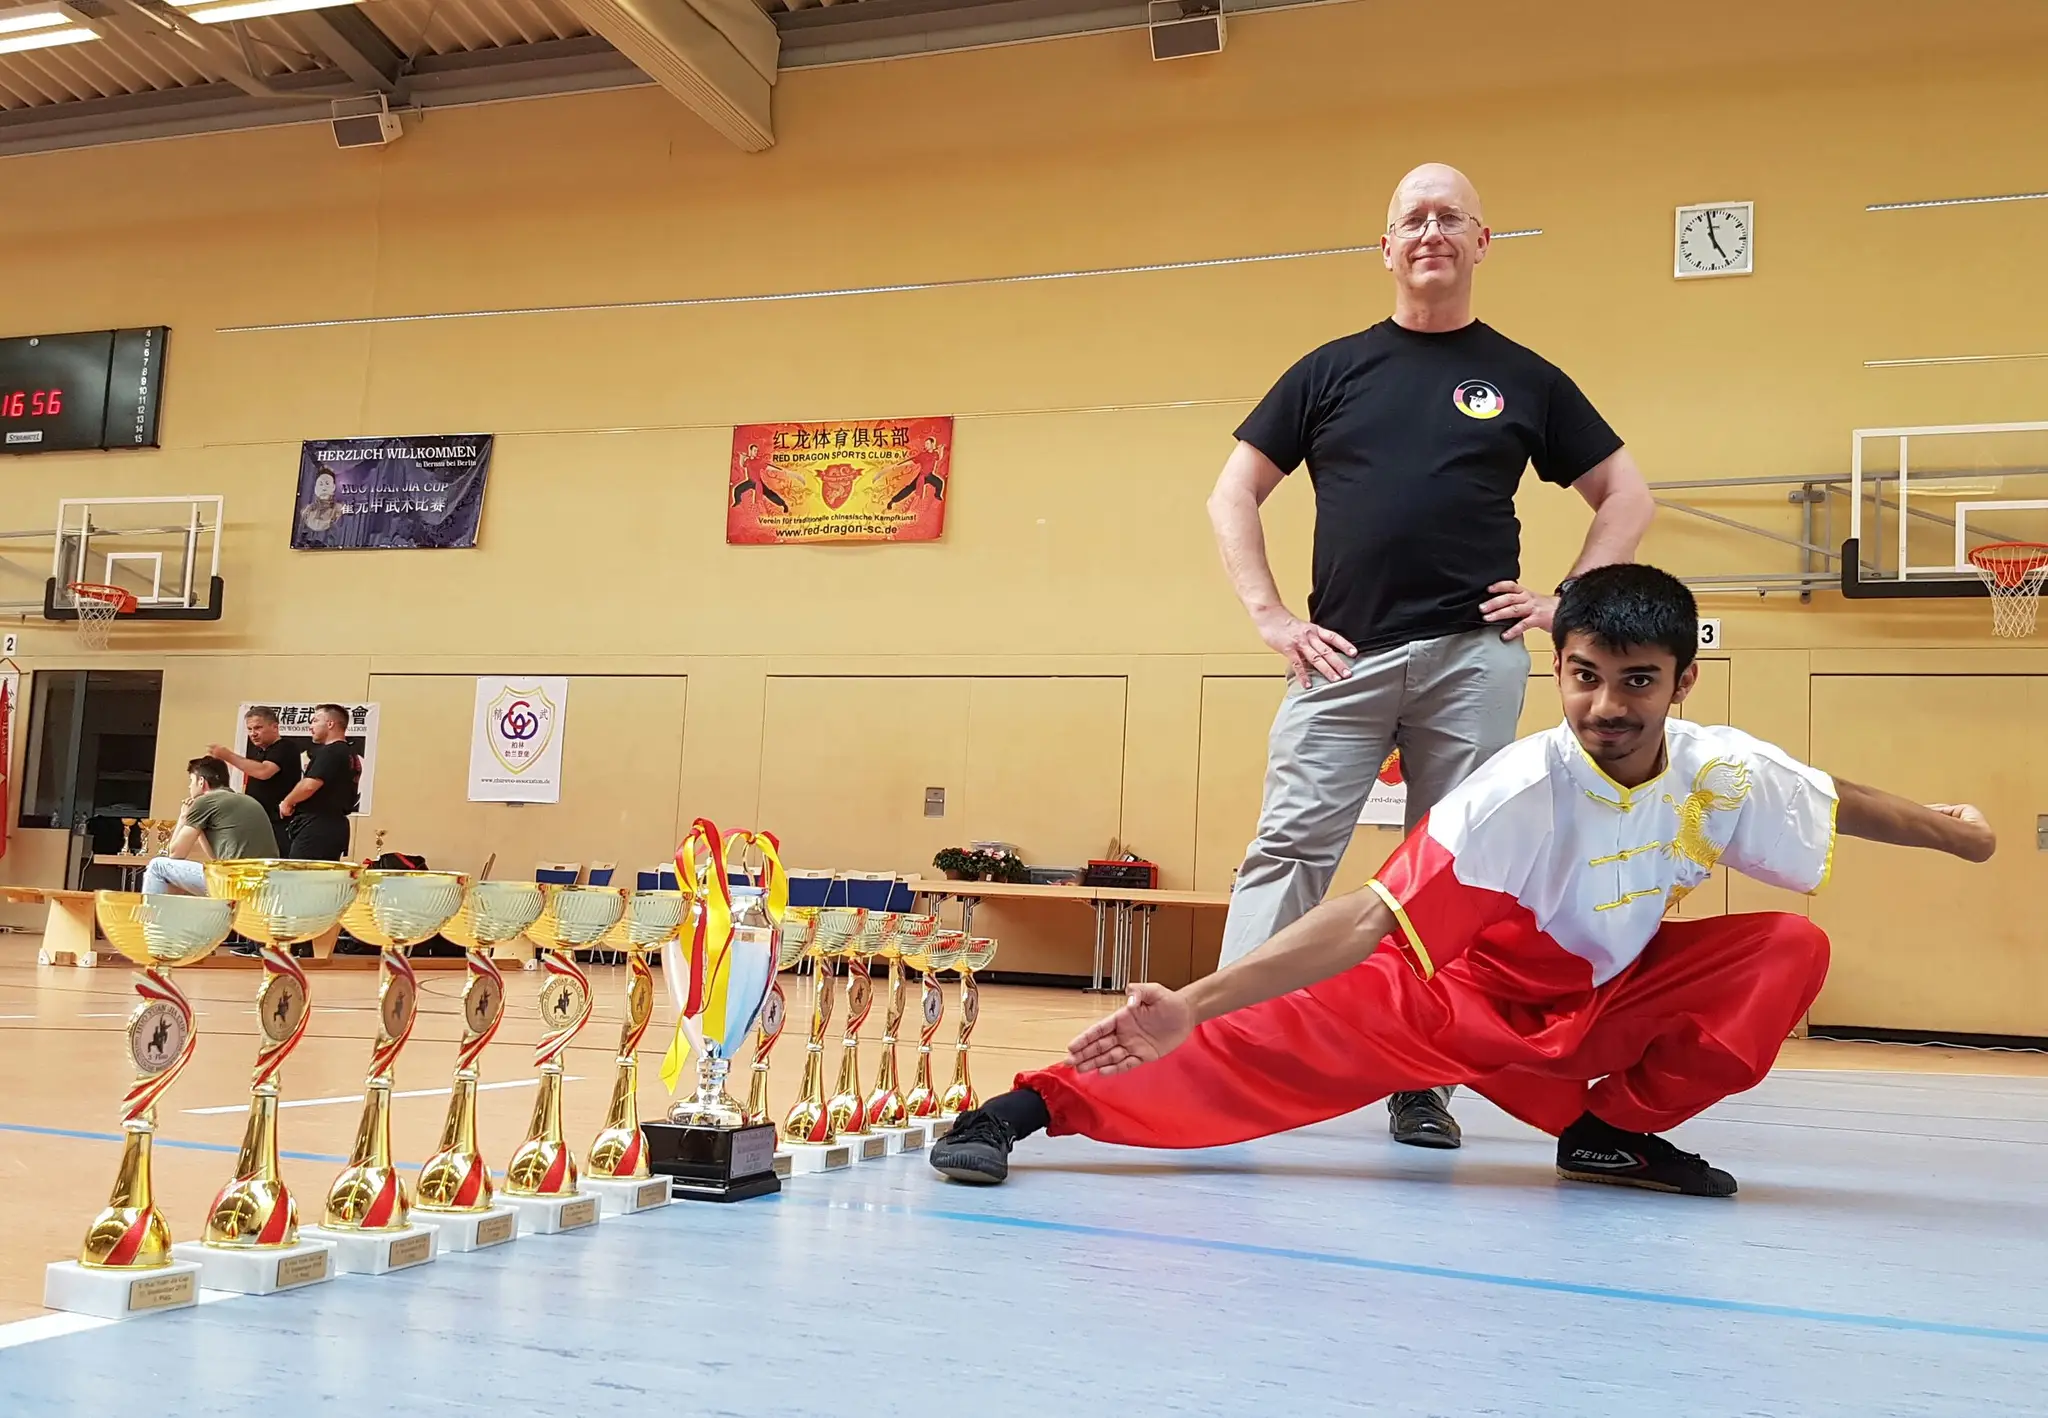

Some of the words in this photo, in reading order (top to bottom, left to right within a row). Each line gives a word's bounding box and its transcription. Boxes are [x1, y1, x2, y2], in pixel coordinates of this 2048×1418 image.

[144, 348, 150, 357] 6
[144, 358, 149, 366] 7
[142, 368, 148, 376] 8
[141, 377, 147, 386] 9
[2, 392, 26, 417] 16
[31, 390, 63, 416] 56
[138, 406, 145, 414] 12
[135, 425, 143, 433] 14
[773, 427, 910, 450] 红龙体育俱乐部
[317, 448, 383, 462] HERZLICH
[387, 446, 477, 460] WILLKOMMEN
[772, 454, 790, 462] RED
[792, 452, 830, 462] DRAGON
[832, 450, 866, 460] SPORTS
[868, 451, 892, 459] CLUB
[402, 482, 420, 492] JIA
[424, 482, 449, 492] CUP
[758, 517, 781, 525] Verein
[782, 517, 793, 525] für
[794, 515, 829, 524] traditionelle
[874, 514, 916, 522] Kampfkunst
[776, 524, 898, 538] www.red-dragon-sc.de
[1701, 624, 1714, 644] 3
[6, 637, 14, 651] 2
